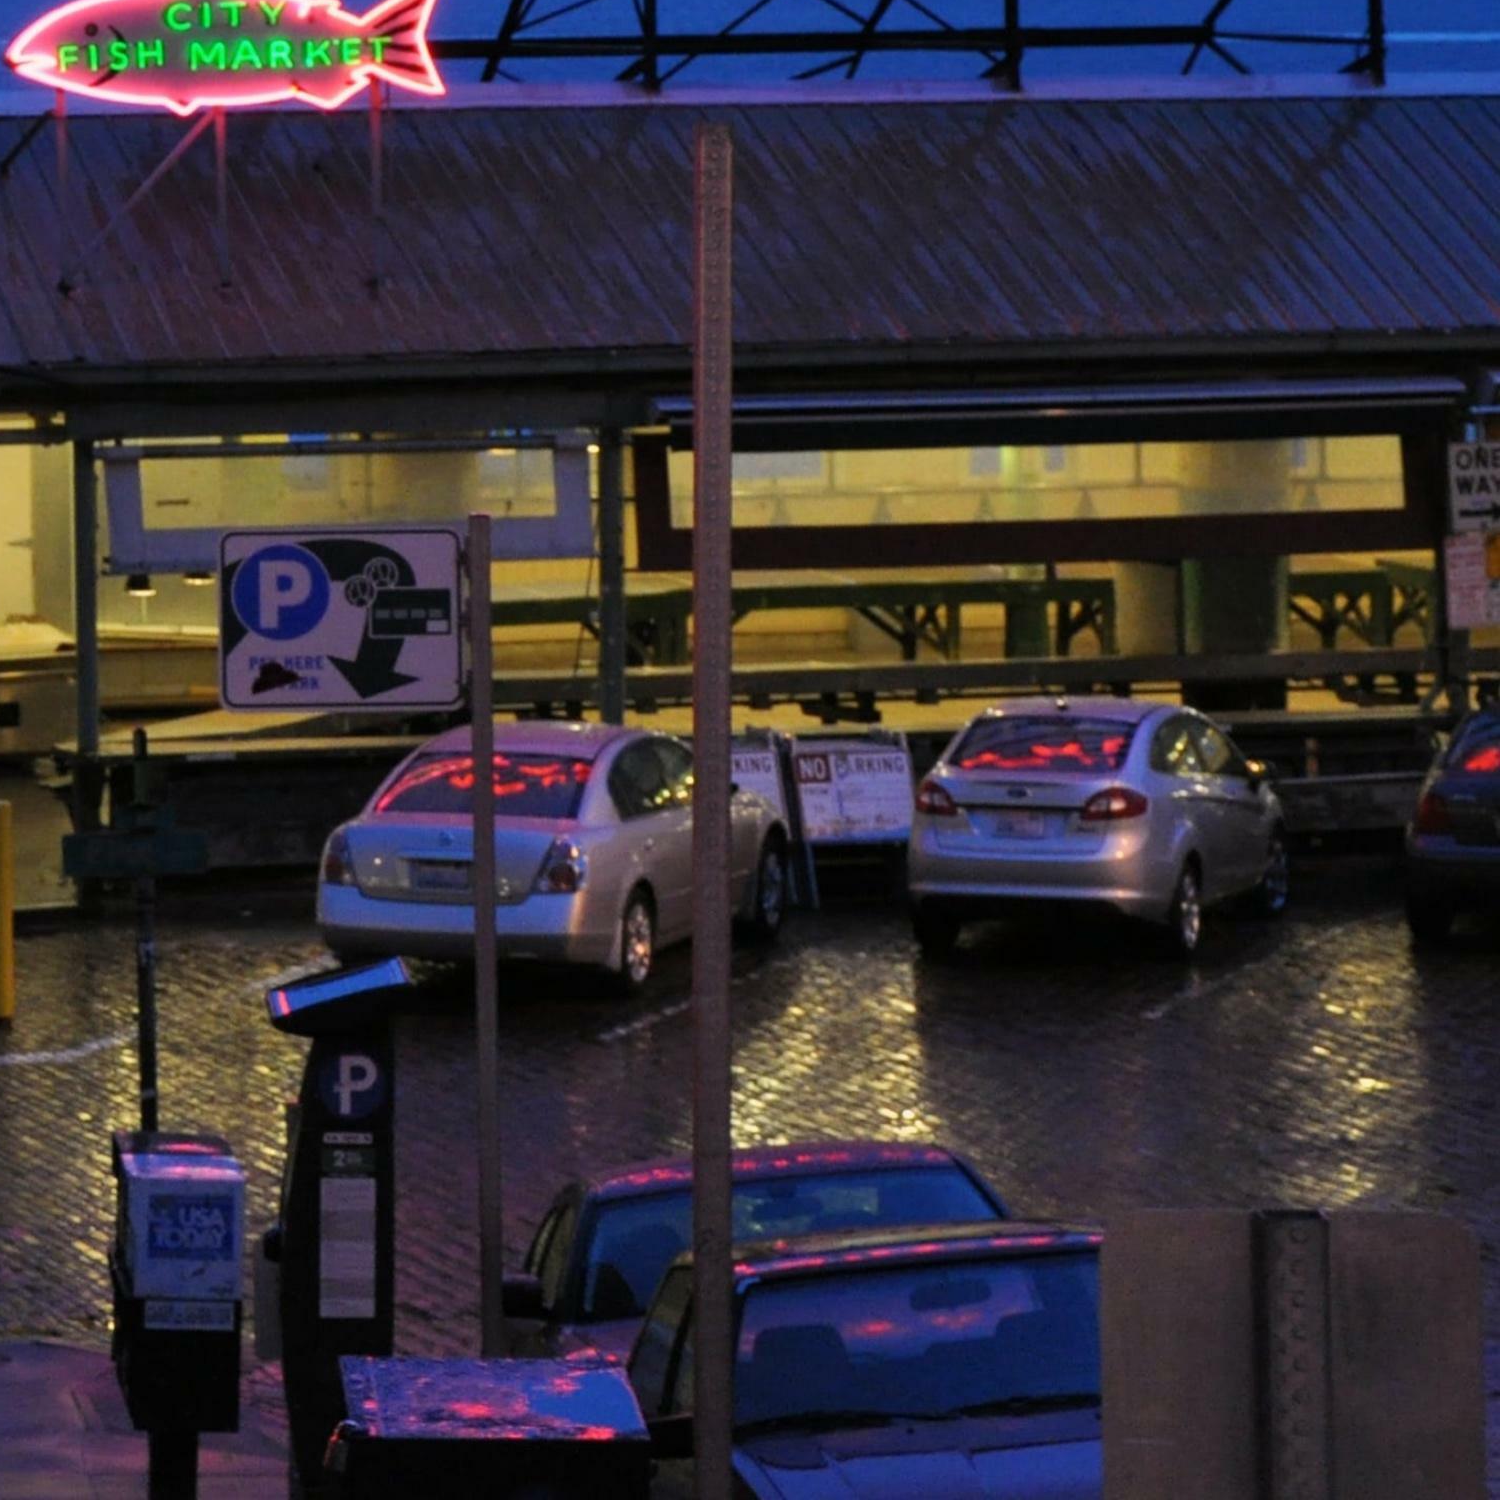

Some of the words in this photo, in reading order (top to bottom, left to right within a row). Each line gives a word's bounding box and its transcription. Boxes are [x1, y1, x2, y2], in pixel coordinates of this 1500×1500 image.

[163, 0, 286, 32] CITY
[57, 39, 165, 72] FISH
[189, 35, 393, 71] MARKET
[259, 560, 313, 629] P
[284, 656, 325, 670] HERE
[733, 755, 772, 773] KING
[798, 757, 827, 781] NO
[178, 1205, 225, 1227] USA
[152, 1224, 227, 1249] TODAY
